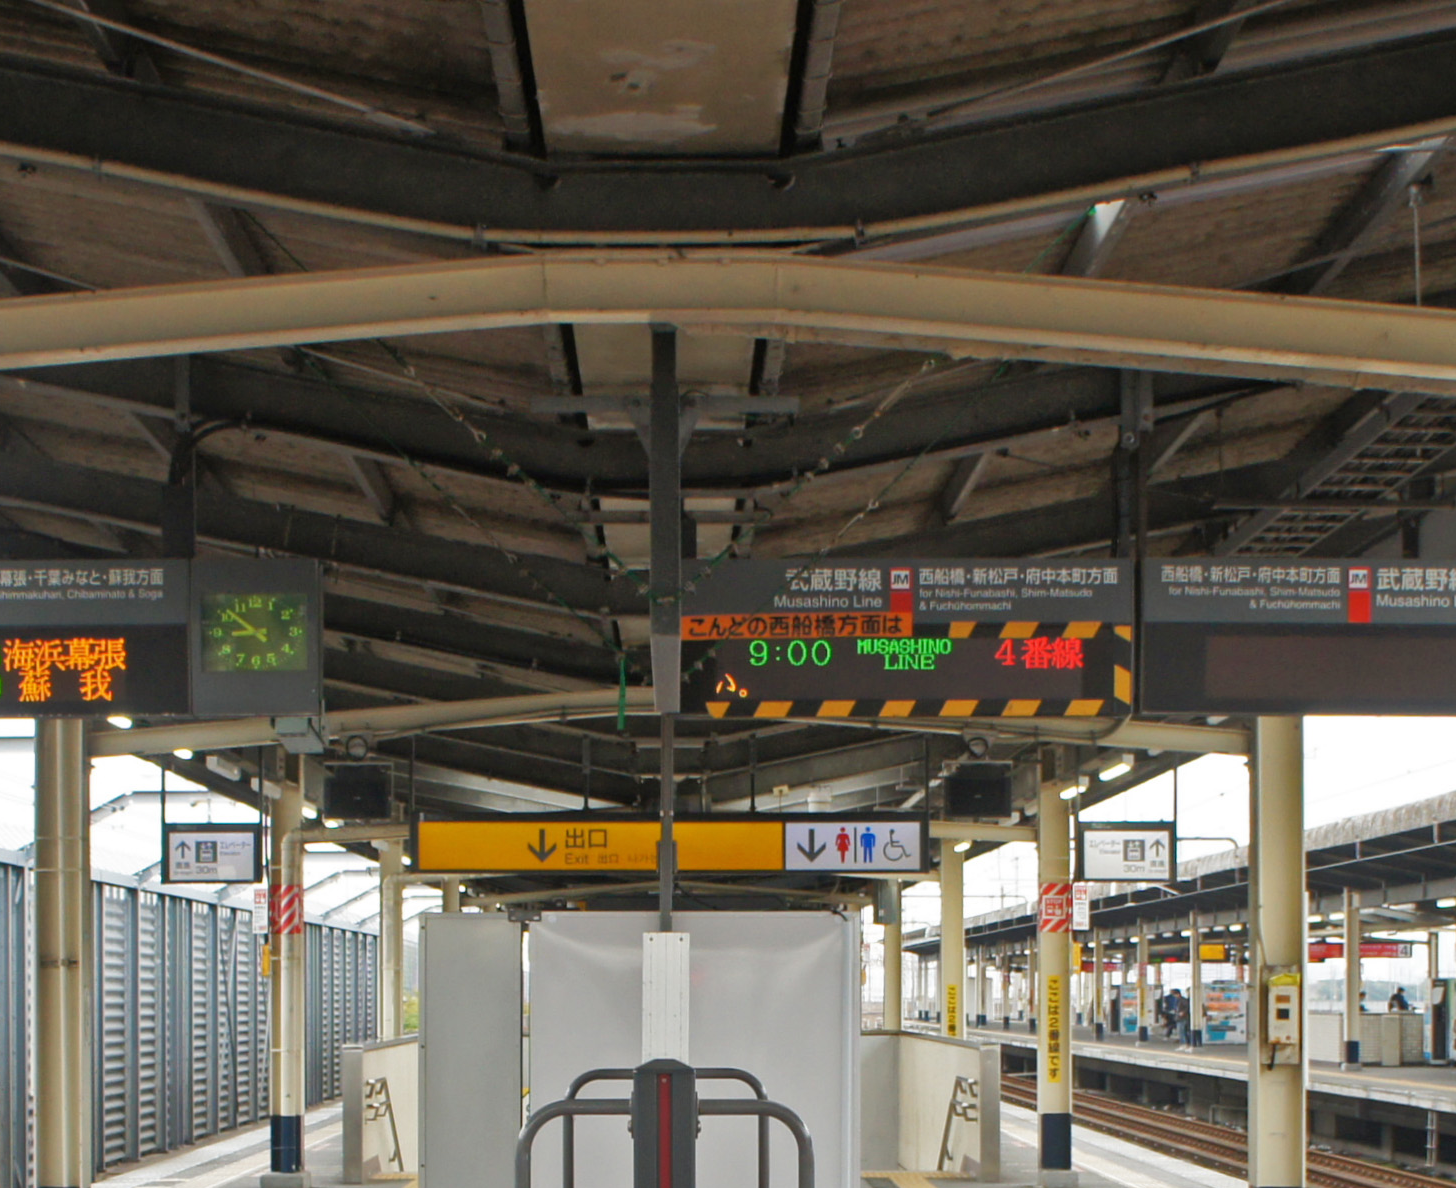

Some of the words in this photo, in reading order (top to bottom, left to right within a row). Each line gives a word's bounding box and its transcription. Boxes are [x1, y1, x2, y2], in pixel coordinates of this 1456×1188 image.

[785, 568, 883, 592] 武蔵野線
[891, 573, 910, 588] JM
[918, 567, 1118, 586] 西船橋・新松戸・府中本町方面
[1160, 566, 1341, 584] 西船橋・新松戸・府中本町方面
[1350, 573, 1368, 586] JM
[773, 594, 849, 608] Musashino
[853, 594, 882, 608] Line
[919, 588, 933, 598] for
[1376, 594, 1450, 608] Musashino
[919, 601, 927, 611] &
[688, 612, 903, 638] こんどの西船橋方面は
[3, 639, 127, 672] 海浜幕張
[749, 639, 832, 667] 9:00
[856, 638, 951, 656] MUSASHINO
[994, 637, 1084, 669] 4番線
[883, 654, 935, 670] LINE
[565, 827, 608, 849] 出口
[565, 853, 590, 865] Exit
[1123, 864, 1145, 873] 30m
